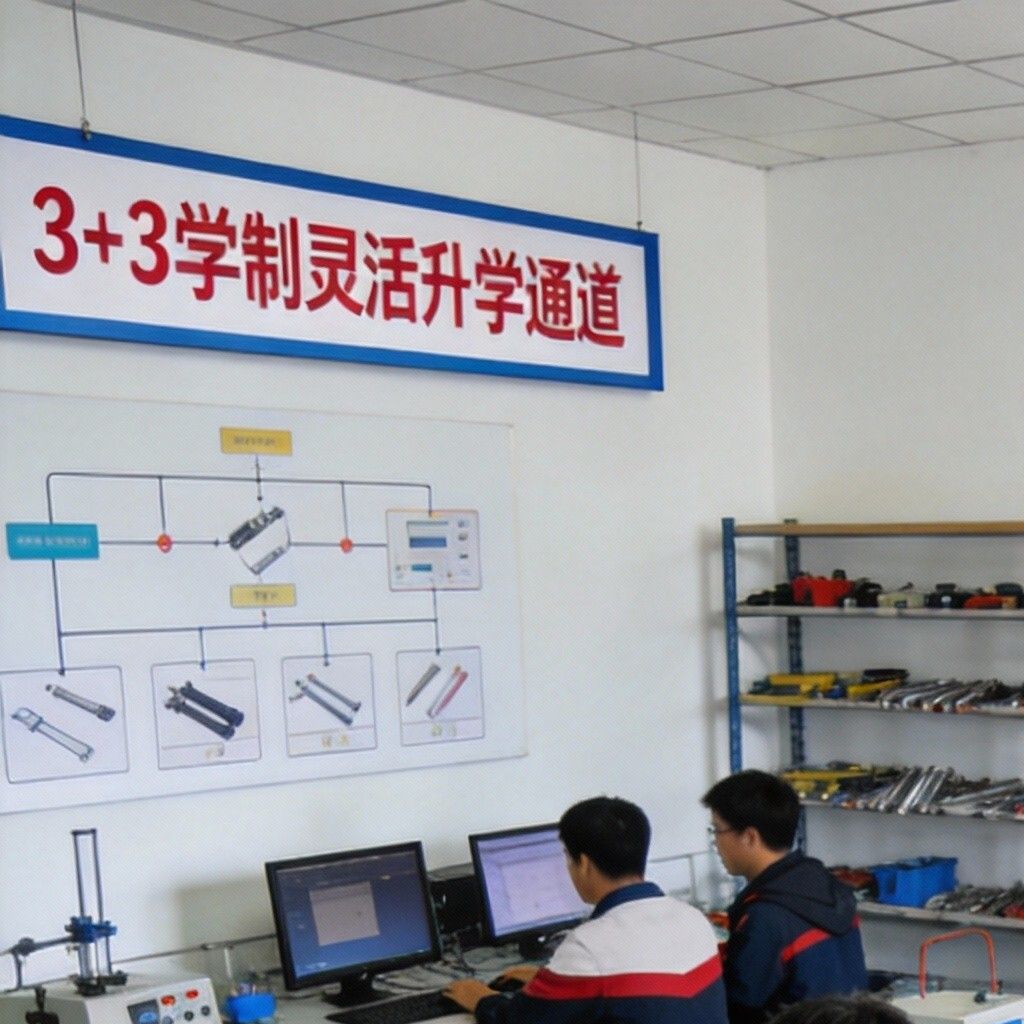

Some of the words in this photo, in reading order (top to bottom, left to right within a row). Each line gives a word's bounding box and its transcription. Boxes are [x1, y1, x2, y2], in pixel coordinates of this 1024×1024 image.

[33, 186, 625, 347] 3+3学制灵活升学通道
